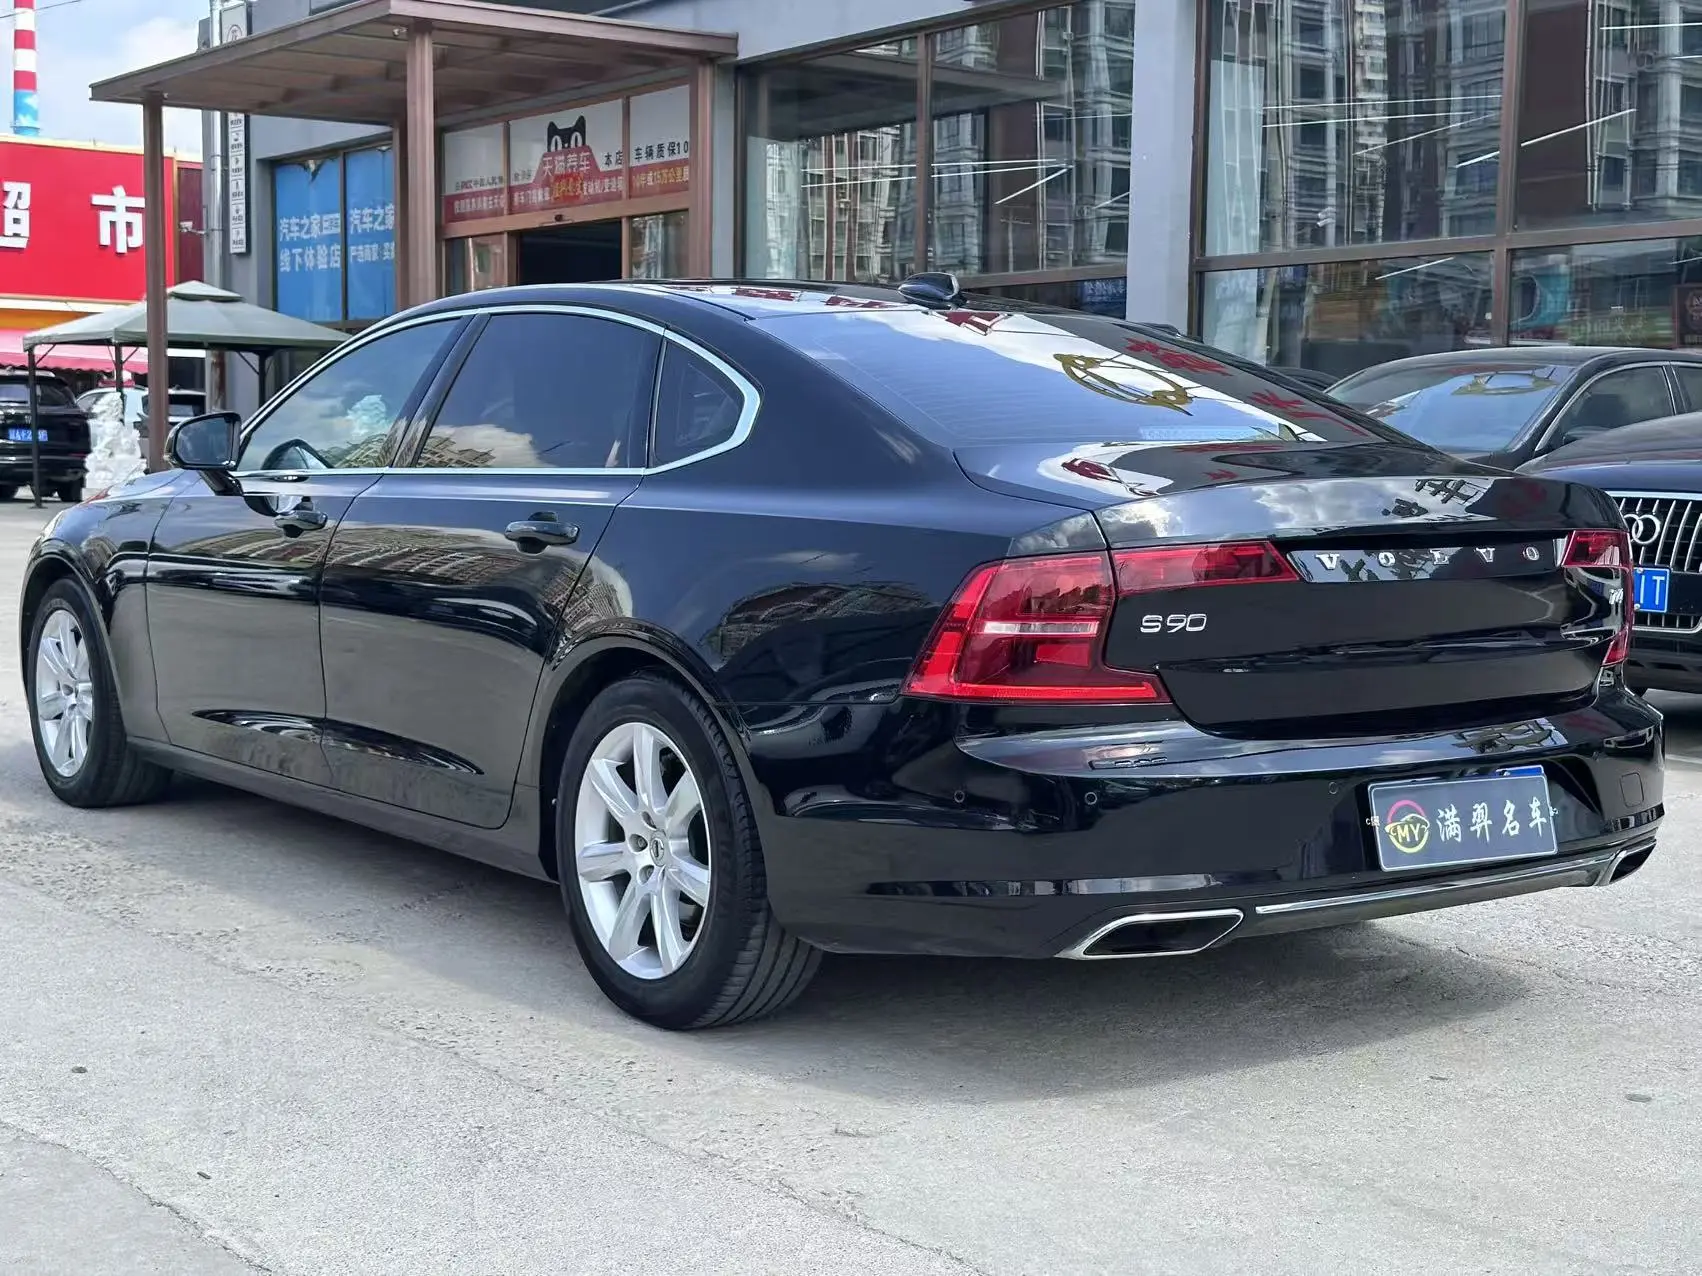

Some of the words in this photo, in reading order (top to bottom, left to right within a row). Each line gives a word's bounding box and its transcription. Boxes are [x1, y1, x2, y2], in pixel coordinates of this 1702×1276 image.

[604, 150, 623, 166] 本店
[1316, 546, 1540, 571] VOLVO
[1140, 613, 1207, 633] S90
